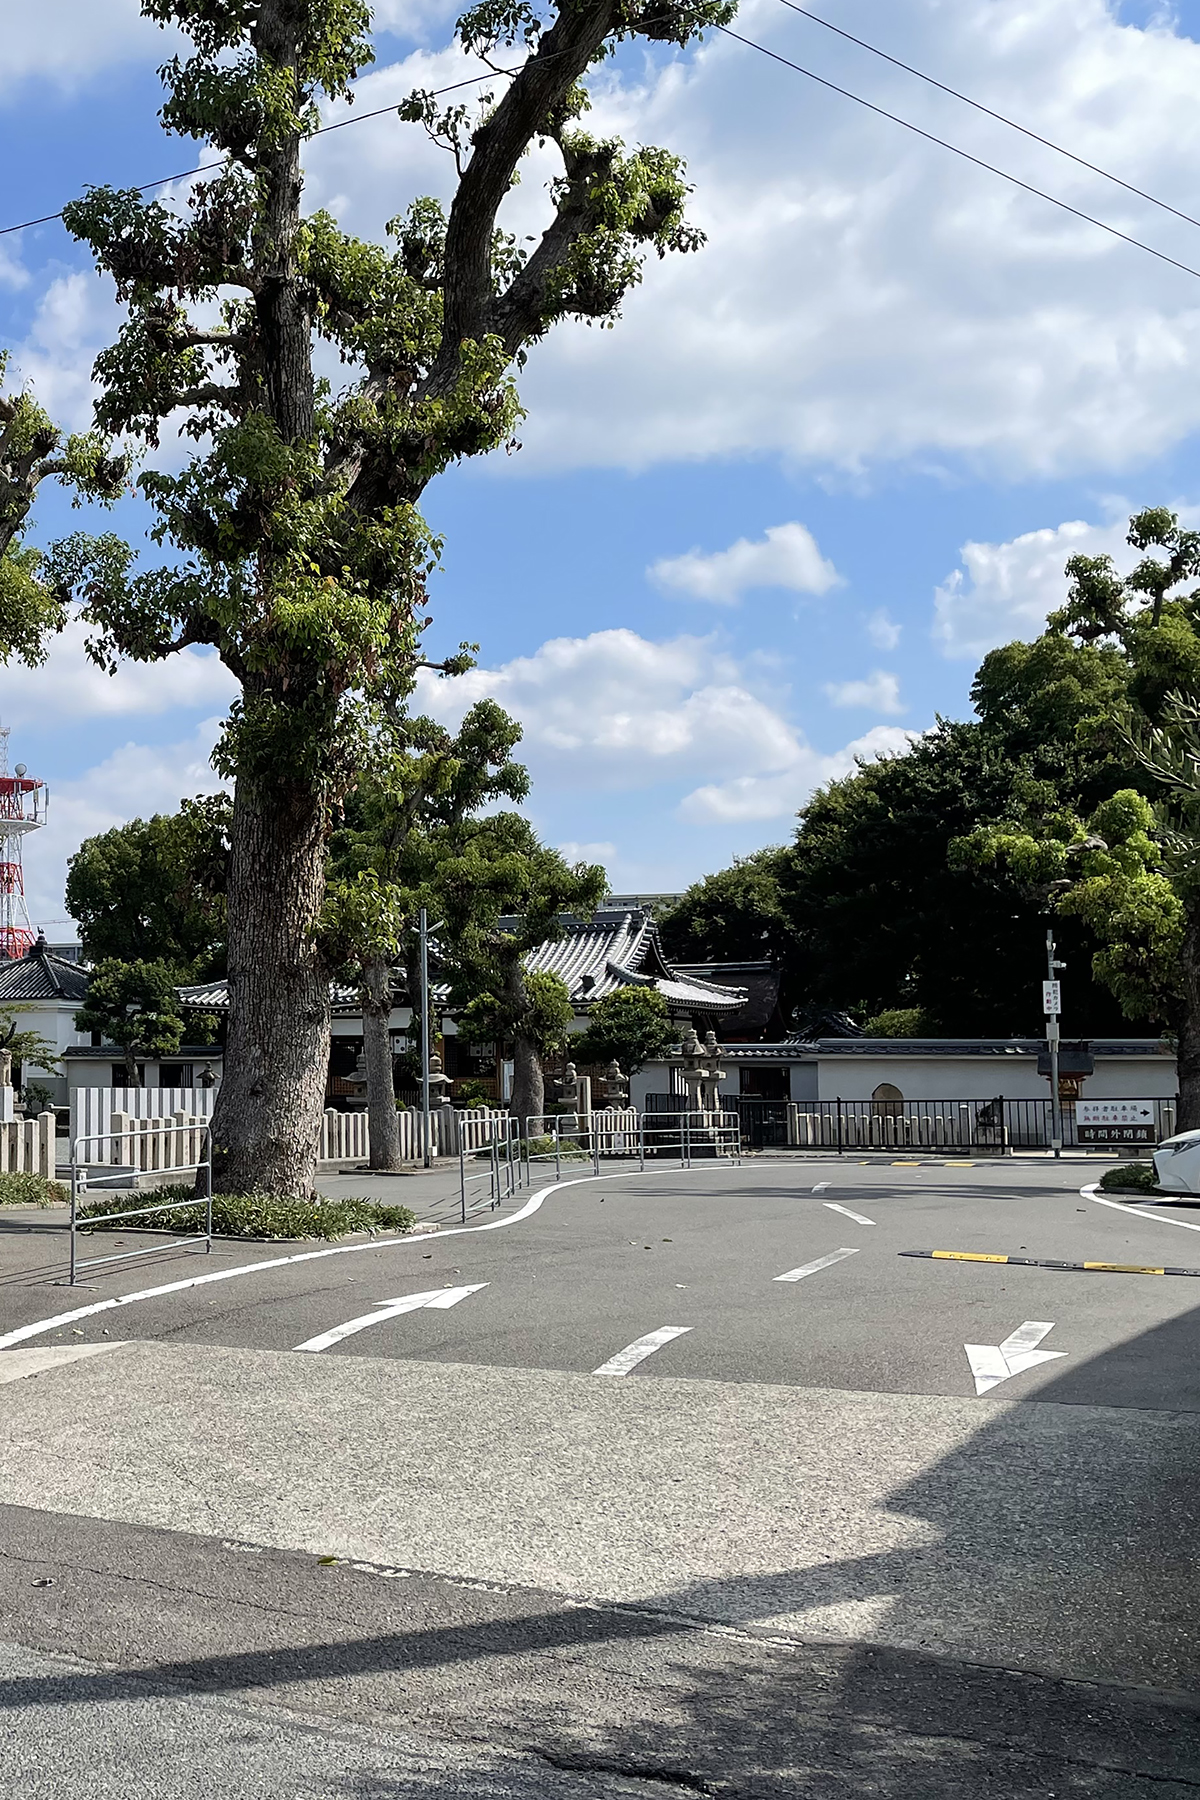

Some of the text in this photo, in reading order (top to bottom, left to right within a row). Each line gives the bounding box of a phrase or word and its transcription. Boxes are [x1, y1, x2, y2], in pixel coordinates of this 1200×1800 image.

[1084, 1128, 1148, 1140] 時間外閉鎖
